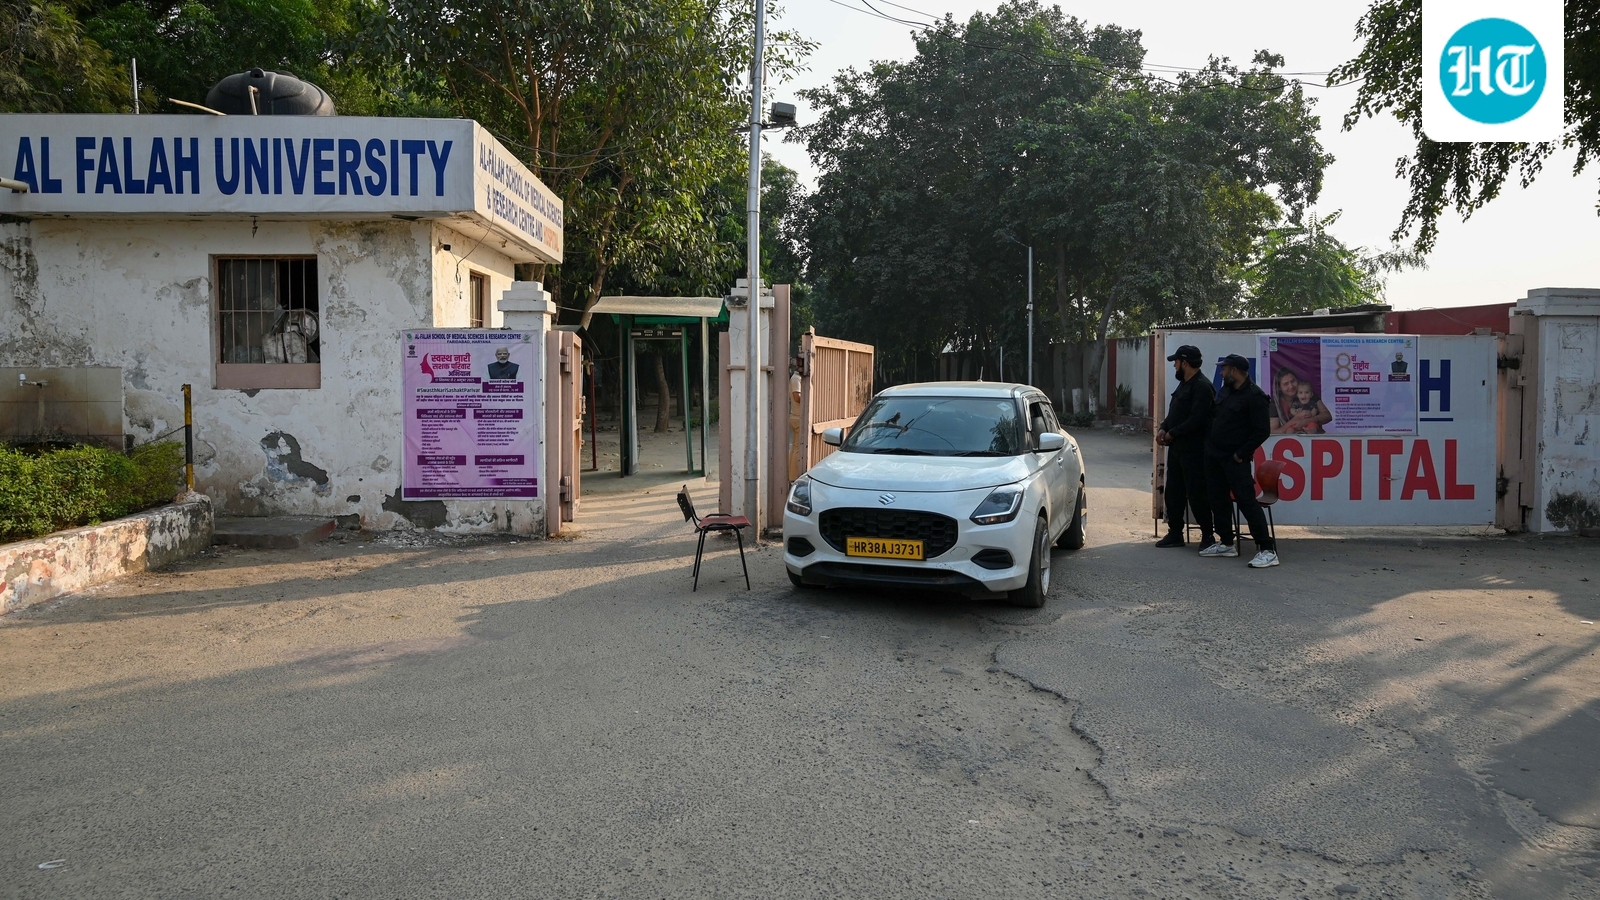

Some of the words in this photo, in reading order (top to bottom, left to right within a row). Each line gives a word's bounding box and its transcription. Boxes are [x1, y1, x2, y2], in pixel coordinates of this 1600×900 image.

[12, 137, 62, 193] AL
[76, 137, 200, 195] FALAH
[214, 137, 453, 197] UNIVERSITY
[479, 142, 505, 185] AL-FALAH
[506, 164, 524, 200] SCHOOL
[525, 180, 530, 204] OF
[530, 185, 546, 217] MEDICAL
[546, 199, 562, 229] SCIENCES
[486, 184, 491, 209] &
[493, 188, 518, 227] RESEARCH
[519, 206, 535, 238] CENTRE
[535, 218, 543, 243] AND
[431, 354, 453, 362] स्वस्थ
[453, 352, 471, 363] नारी
[451, 362, 471, 370] परिवार
[854, 542, 920, 556] HR38AJ3731
